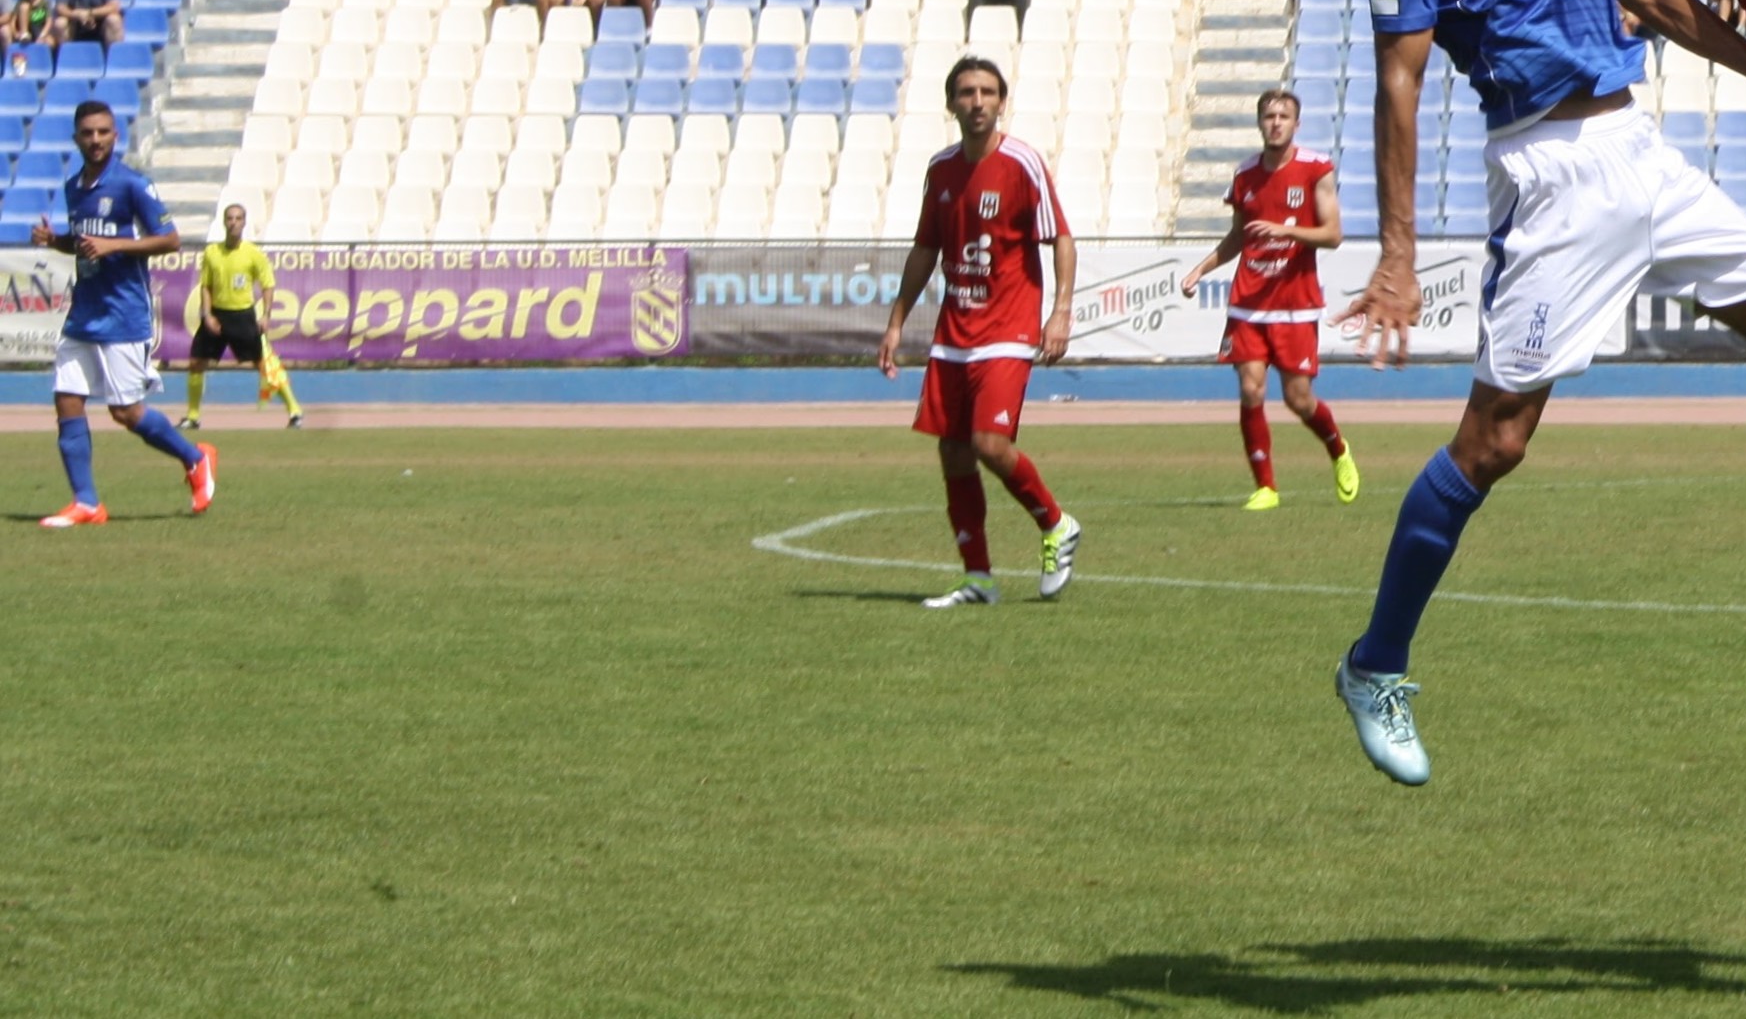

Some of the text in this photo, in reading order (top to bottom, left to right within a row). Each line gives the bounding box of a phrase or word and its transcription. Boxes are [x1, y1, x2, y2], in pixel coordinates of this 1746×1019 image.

[321, 250, 435, 271] JUGADOR
[443, 250, 474, 270] DE
[480, 250, 510, 269] LA
[516, 249, 562, 270] U.D.
[568, 249, 668, 269] MELILLA
[1099, 270, 1176, 316] Miguel
